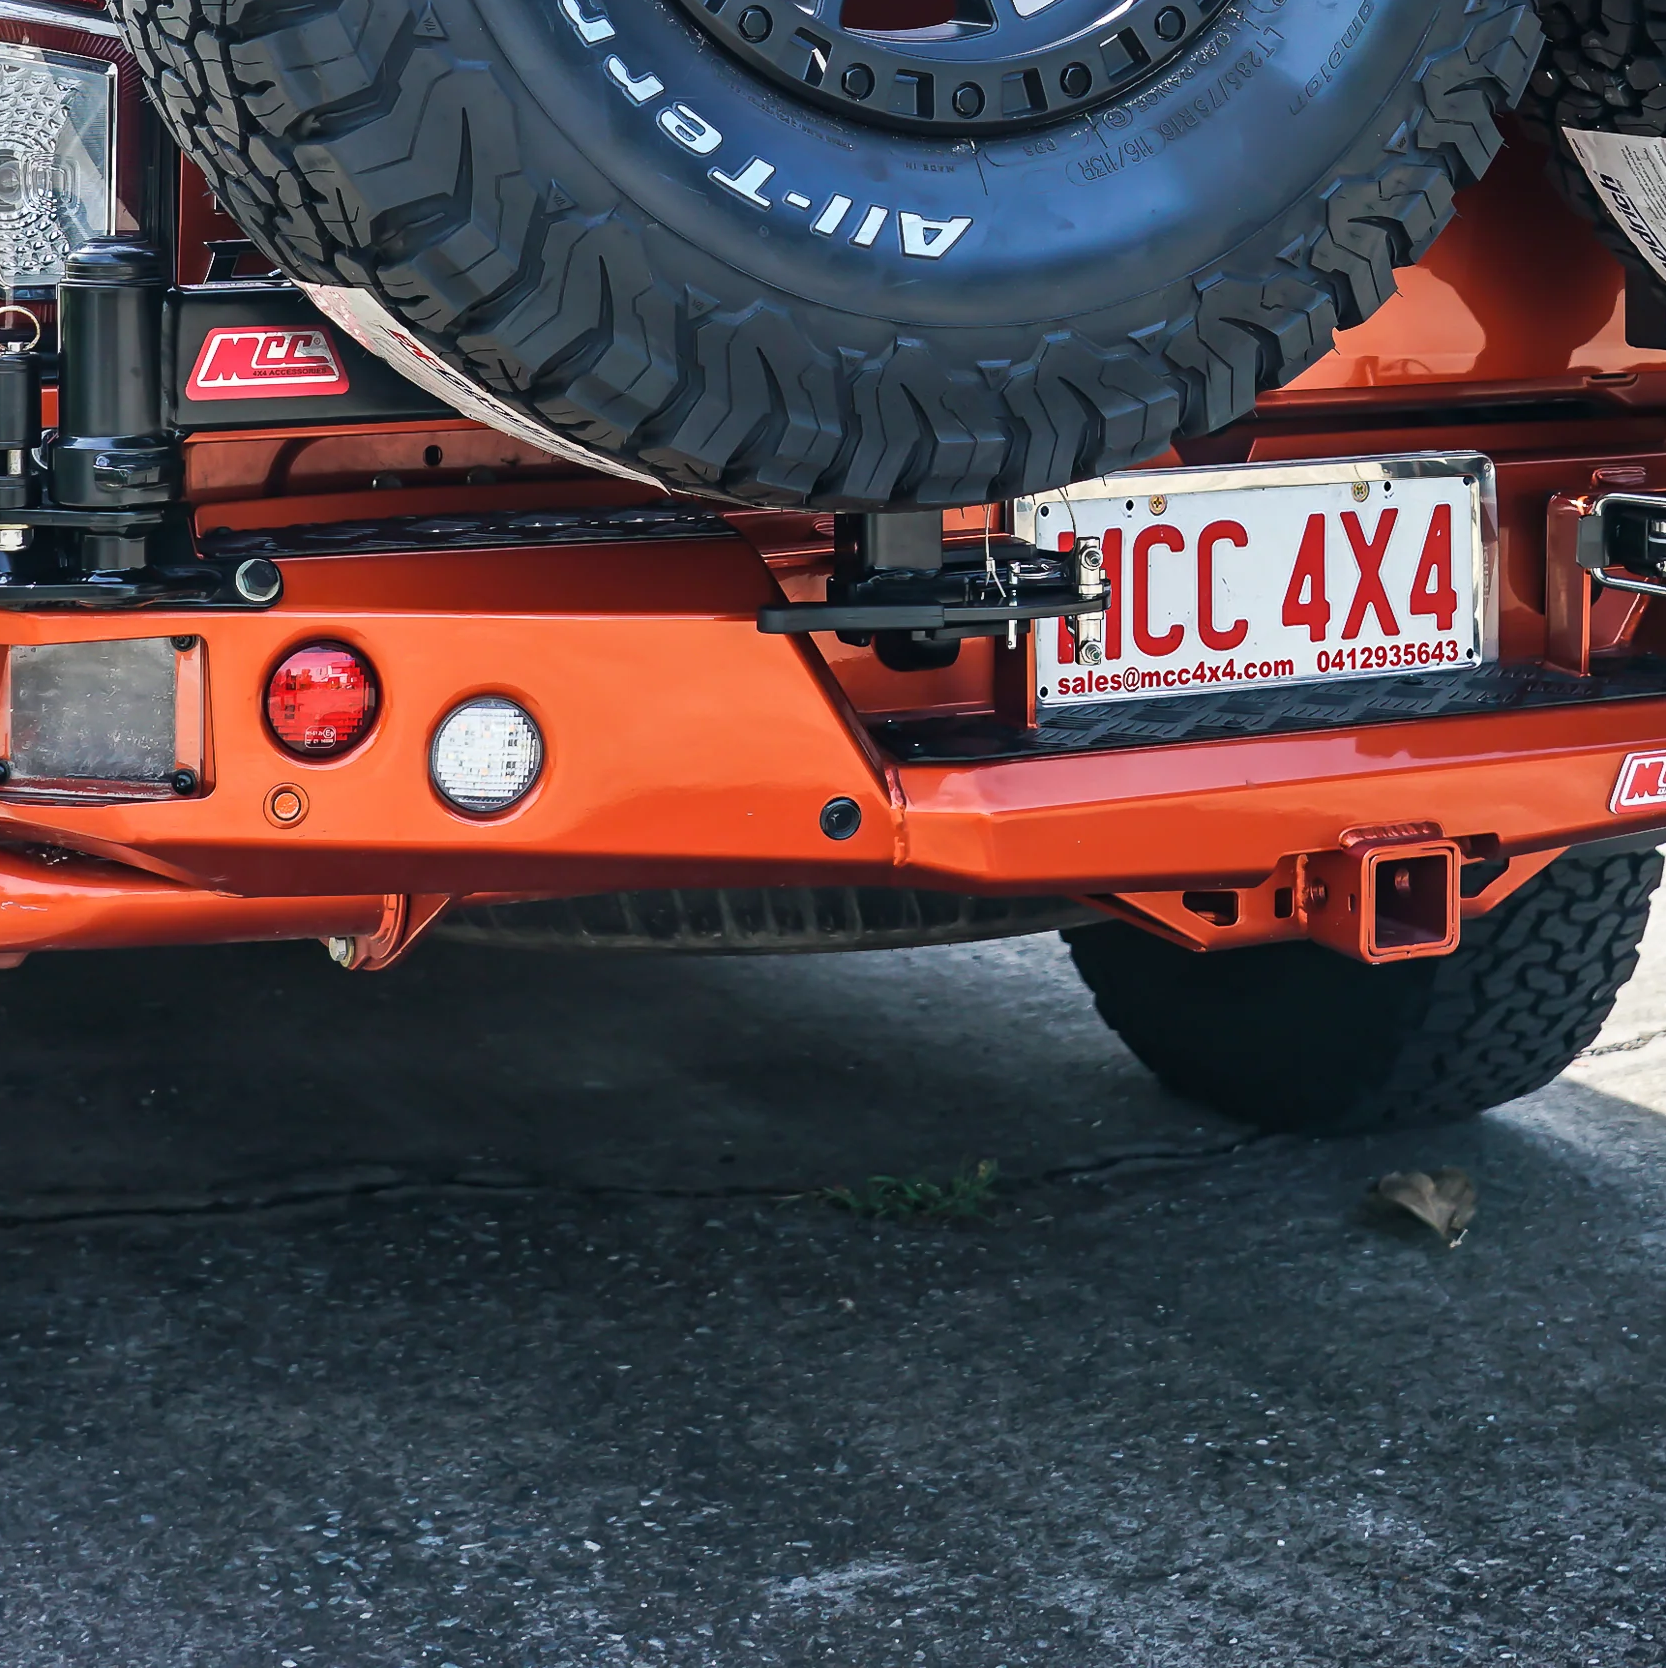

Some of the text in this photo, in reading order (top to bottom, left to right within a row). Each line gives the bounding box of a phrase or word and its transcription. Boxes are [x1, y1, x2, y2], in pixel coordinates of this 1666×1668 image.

[200, 335, 330, 381] MCC
[269, 367, 327, 376] ACCESSORIES
[1281, 504, 1458, 642] 4X4
[1057, 639, 1459, 696] sales@mcc4x4.com 0412935643
